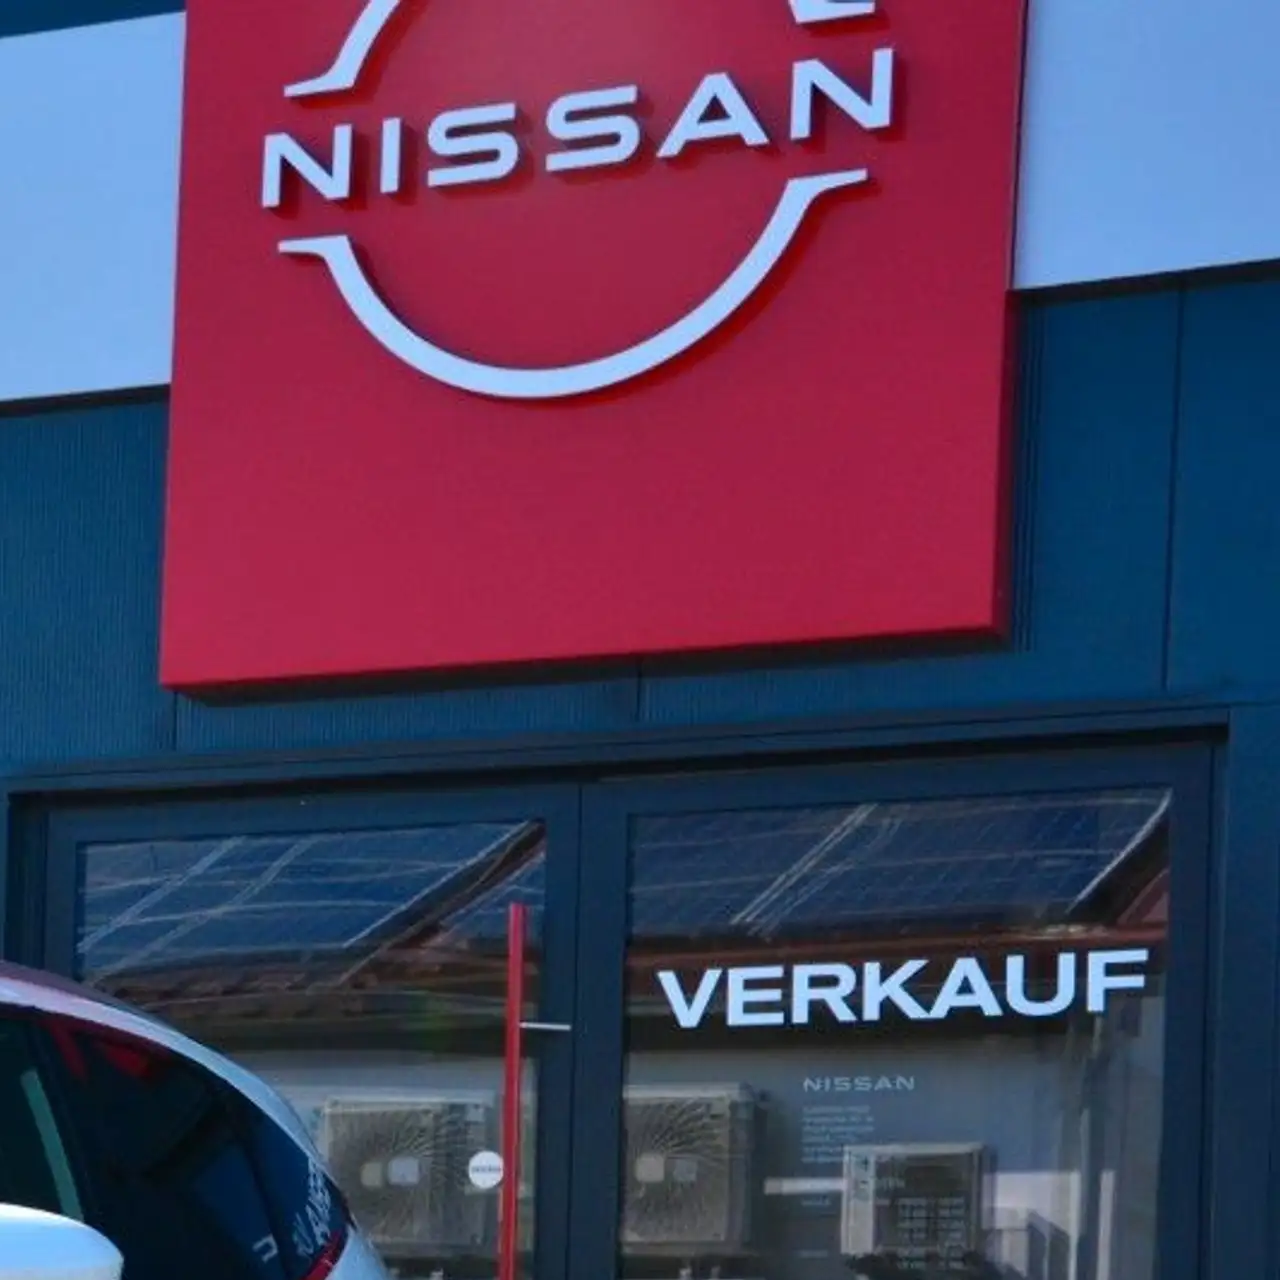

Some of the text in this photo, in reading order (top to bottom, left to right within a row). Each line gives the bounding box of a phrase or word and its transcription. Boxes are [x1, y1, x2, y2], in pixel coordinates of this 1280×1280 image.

[262, 48, 894, 207] NISSAN
[657, 949, 1148, 1028] VERKAUF
[803, 1075, 915, 1093] NISSAN
